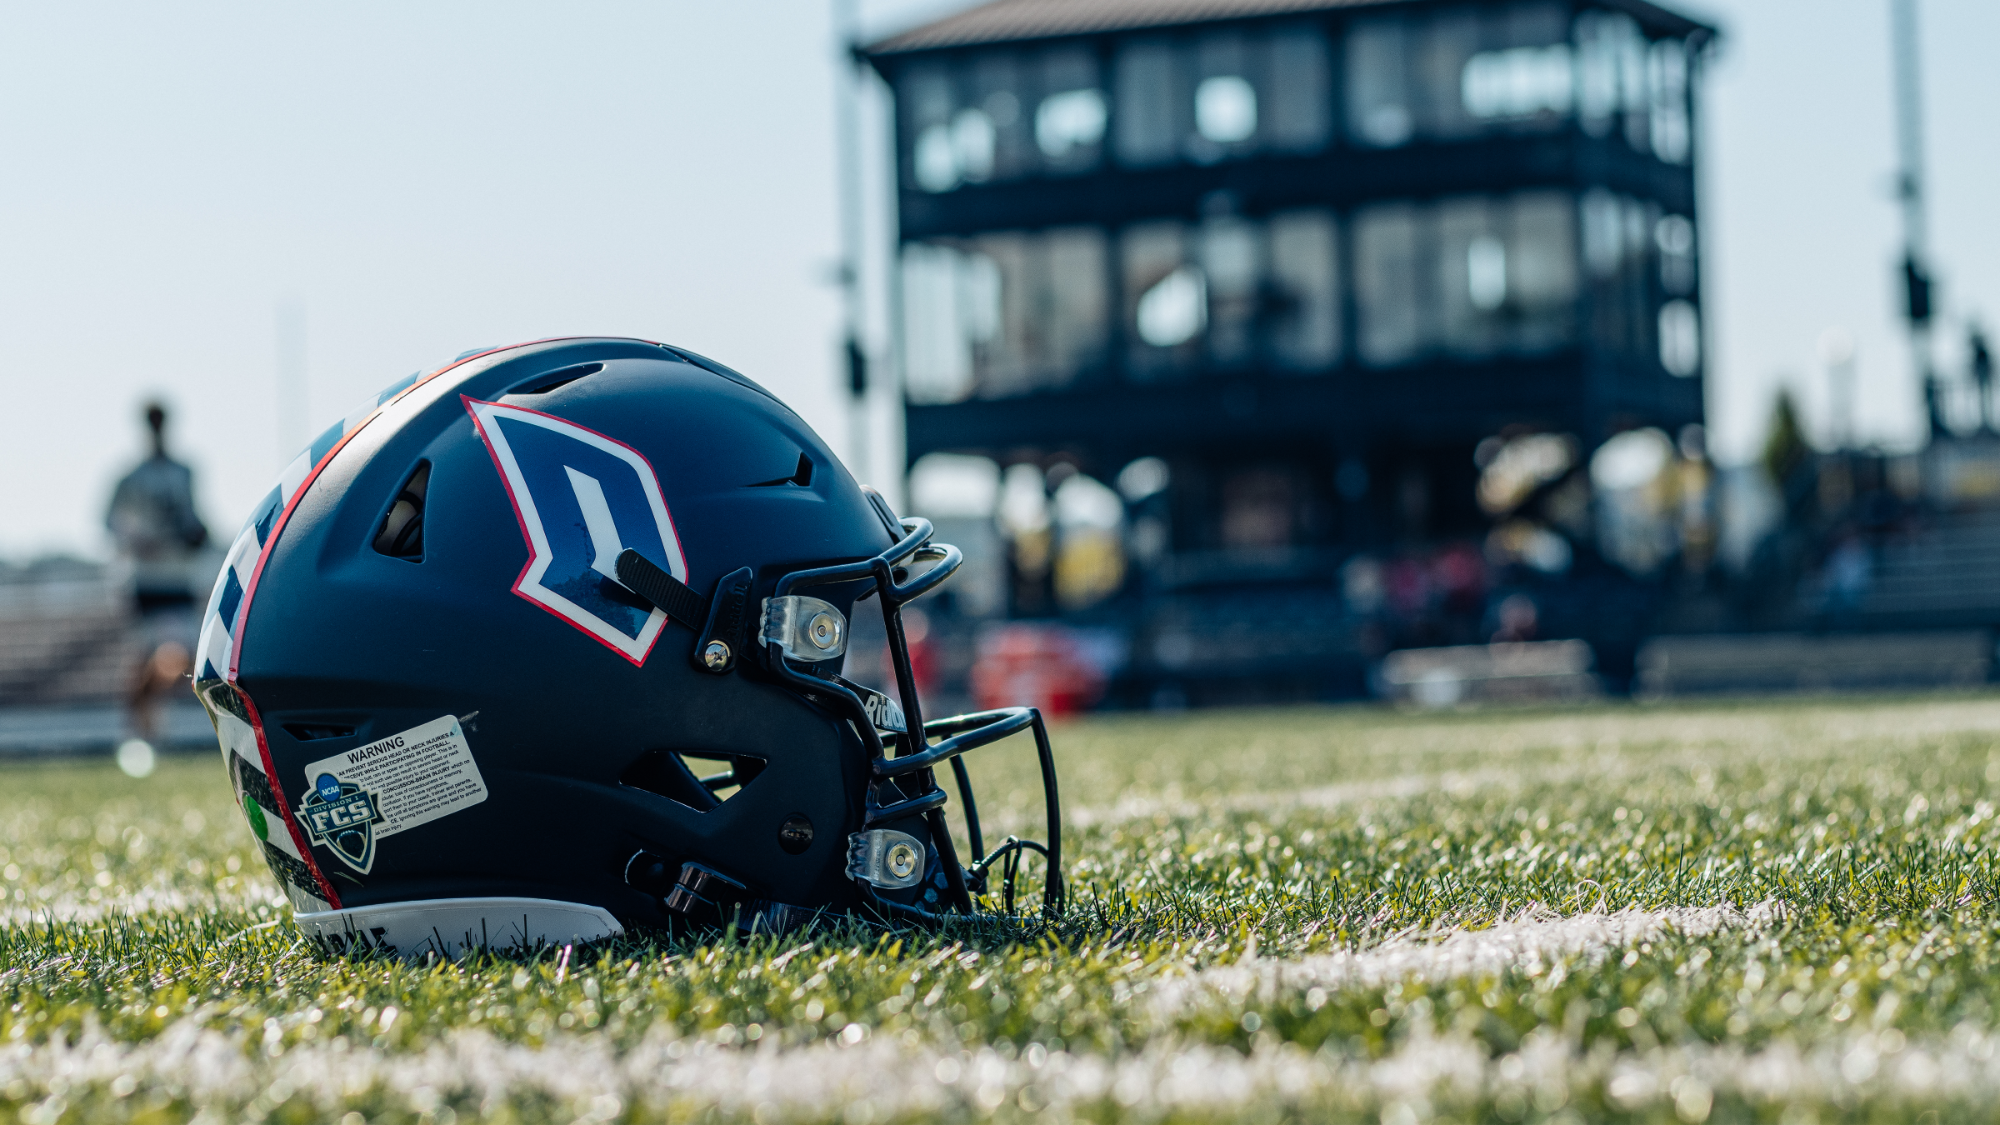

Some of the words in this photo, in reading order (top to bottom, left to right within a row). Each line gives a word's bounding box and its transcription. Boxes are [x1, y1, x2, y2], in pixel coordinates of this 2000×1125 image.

[345, 762, 366, 773] PREVENT
[366, 755, 387, 766] SERIOUS
[387, 750, 402, 758] HEAD
[410, 741, 425, 750] NECK
[425, 732, 449, 744] INJURIES
[346, 735, 404, 764] WARNING
[363, 765, 378, 774] WHILE
[378, 752, 415, 769] PARTICIPATING
[321, 785, 340, 797] NCAA
[382, 772, 431, 794] CONCUSSION-BRAIN
[431, 765, 450, 776] INJURY
[313, 797, 352, 813] DIVISION
[423, 803, 440, 812] warning
[464, 787, 482, 796] another
[311, 800, 371, 832] FCS
